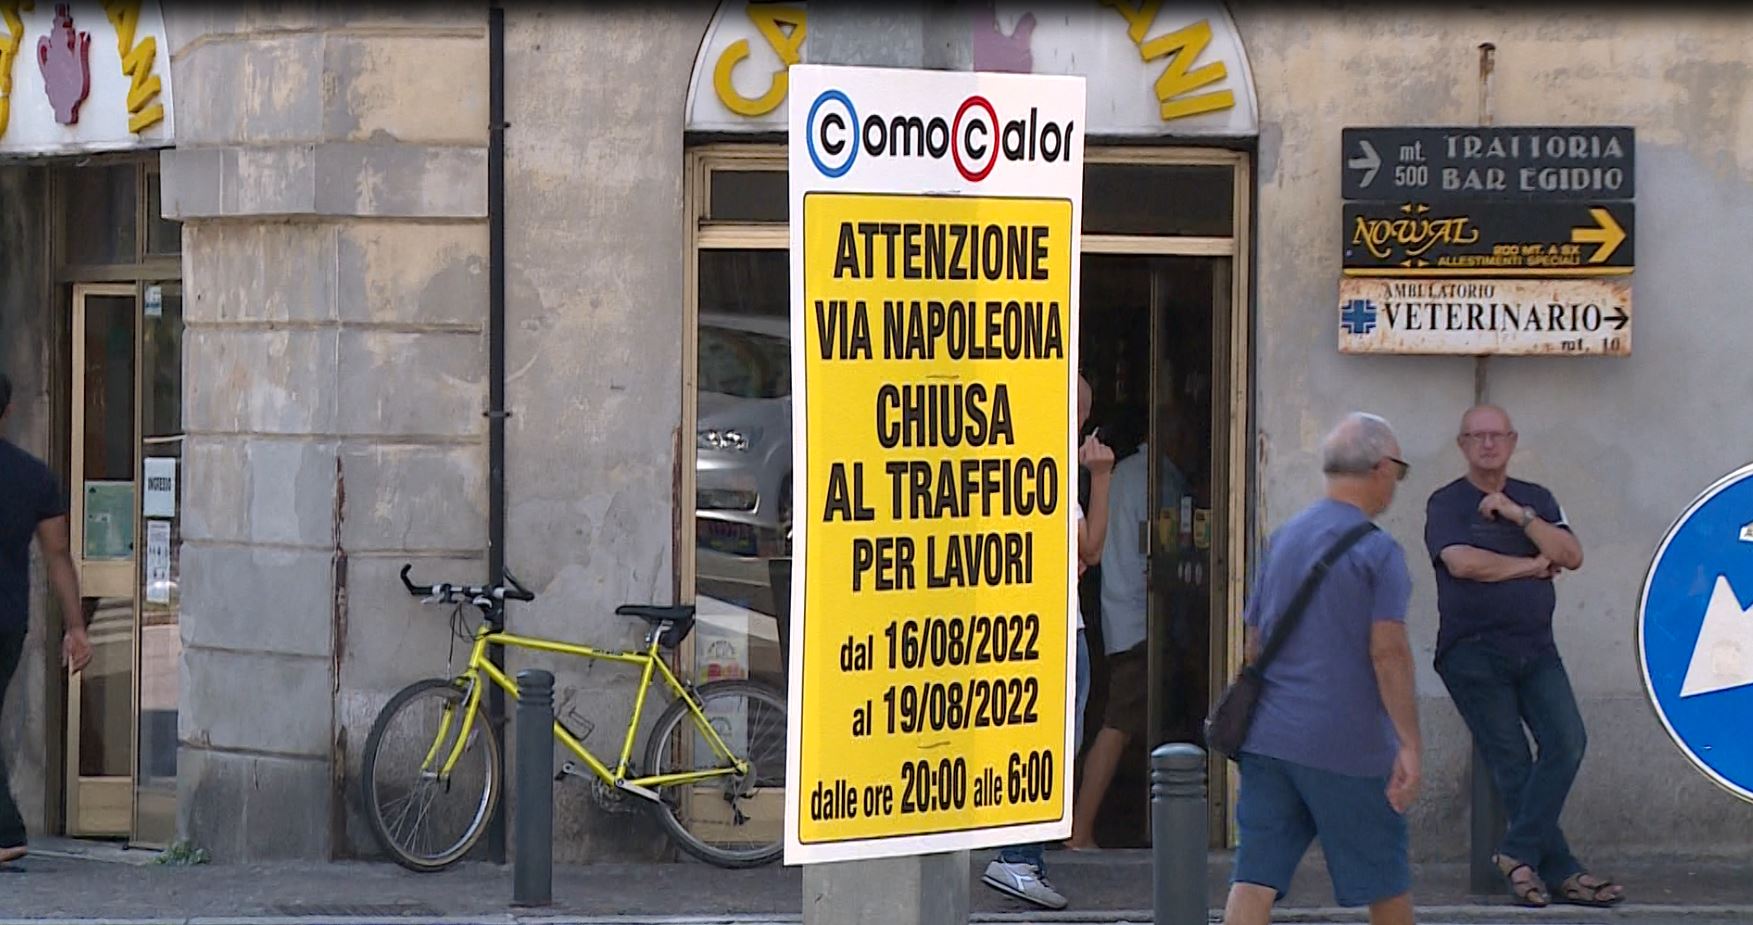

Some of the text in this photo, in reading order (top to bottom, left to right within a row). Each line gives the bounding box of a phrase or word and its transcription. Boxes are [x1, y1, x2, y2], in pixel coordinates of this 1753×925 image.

[1400, 141, 1426, 161] mt.
[1442, 134, 1624, 159] TRATTORIA
[1394, 167, 1428, 187] 500
[1442, 168, 1622, 191] BAR EGIDIO
[834, 221, 1049, 280] ATTENZIONE
[1437, 255, 1581, 267] ALLESTIMENTI SPECIALI
[1383, 283, 1495, 300] AMBULATORIO
[814, 300, 1063, 360] VIA NAPOLEONA
[1384, 303, 1601, 332] VETERINARIO
[1602, 338, 1621, 353] 10
[876, 383, 1015, 448] CHIUSA
[823, 456, 1058, 522] AL TRAFFICO
[852, 531, 1033, 592] PER LAVORI
[840, 613, 1040, 672] dal 16/08/2022
[852, 676, 1039, 736] al 19/08/2022
[811, 750, 1053, 821] dalle ore 20:00 alle 6:00
